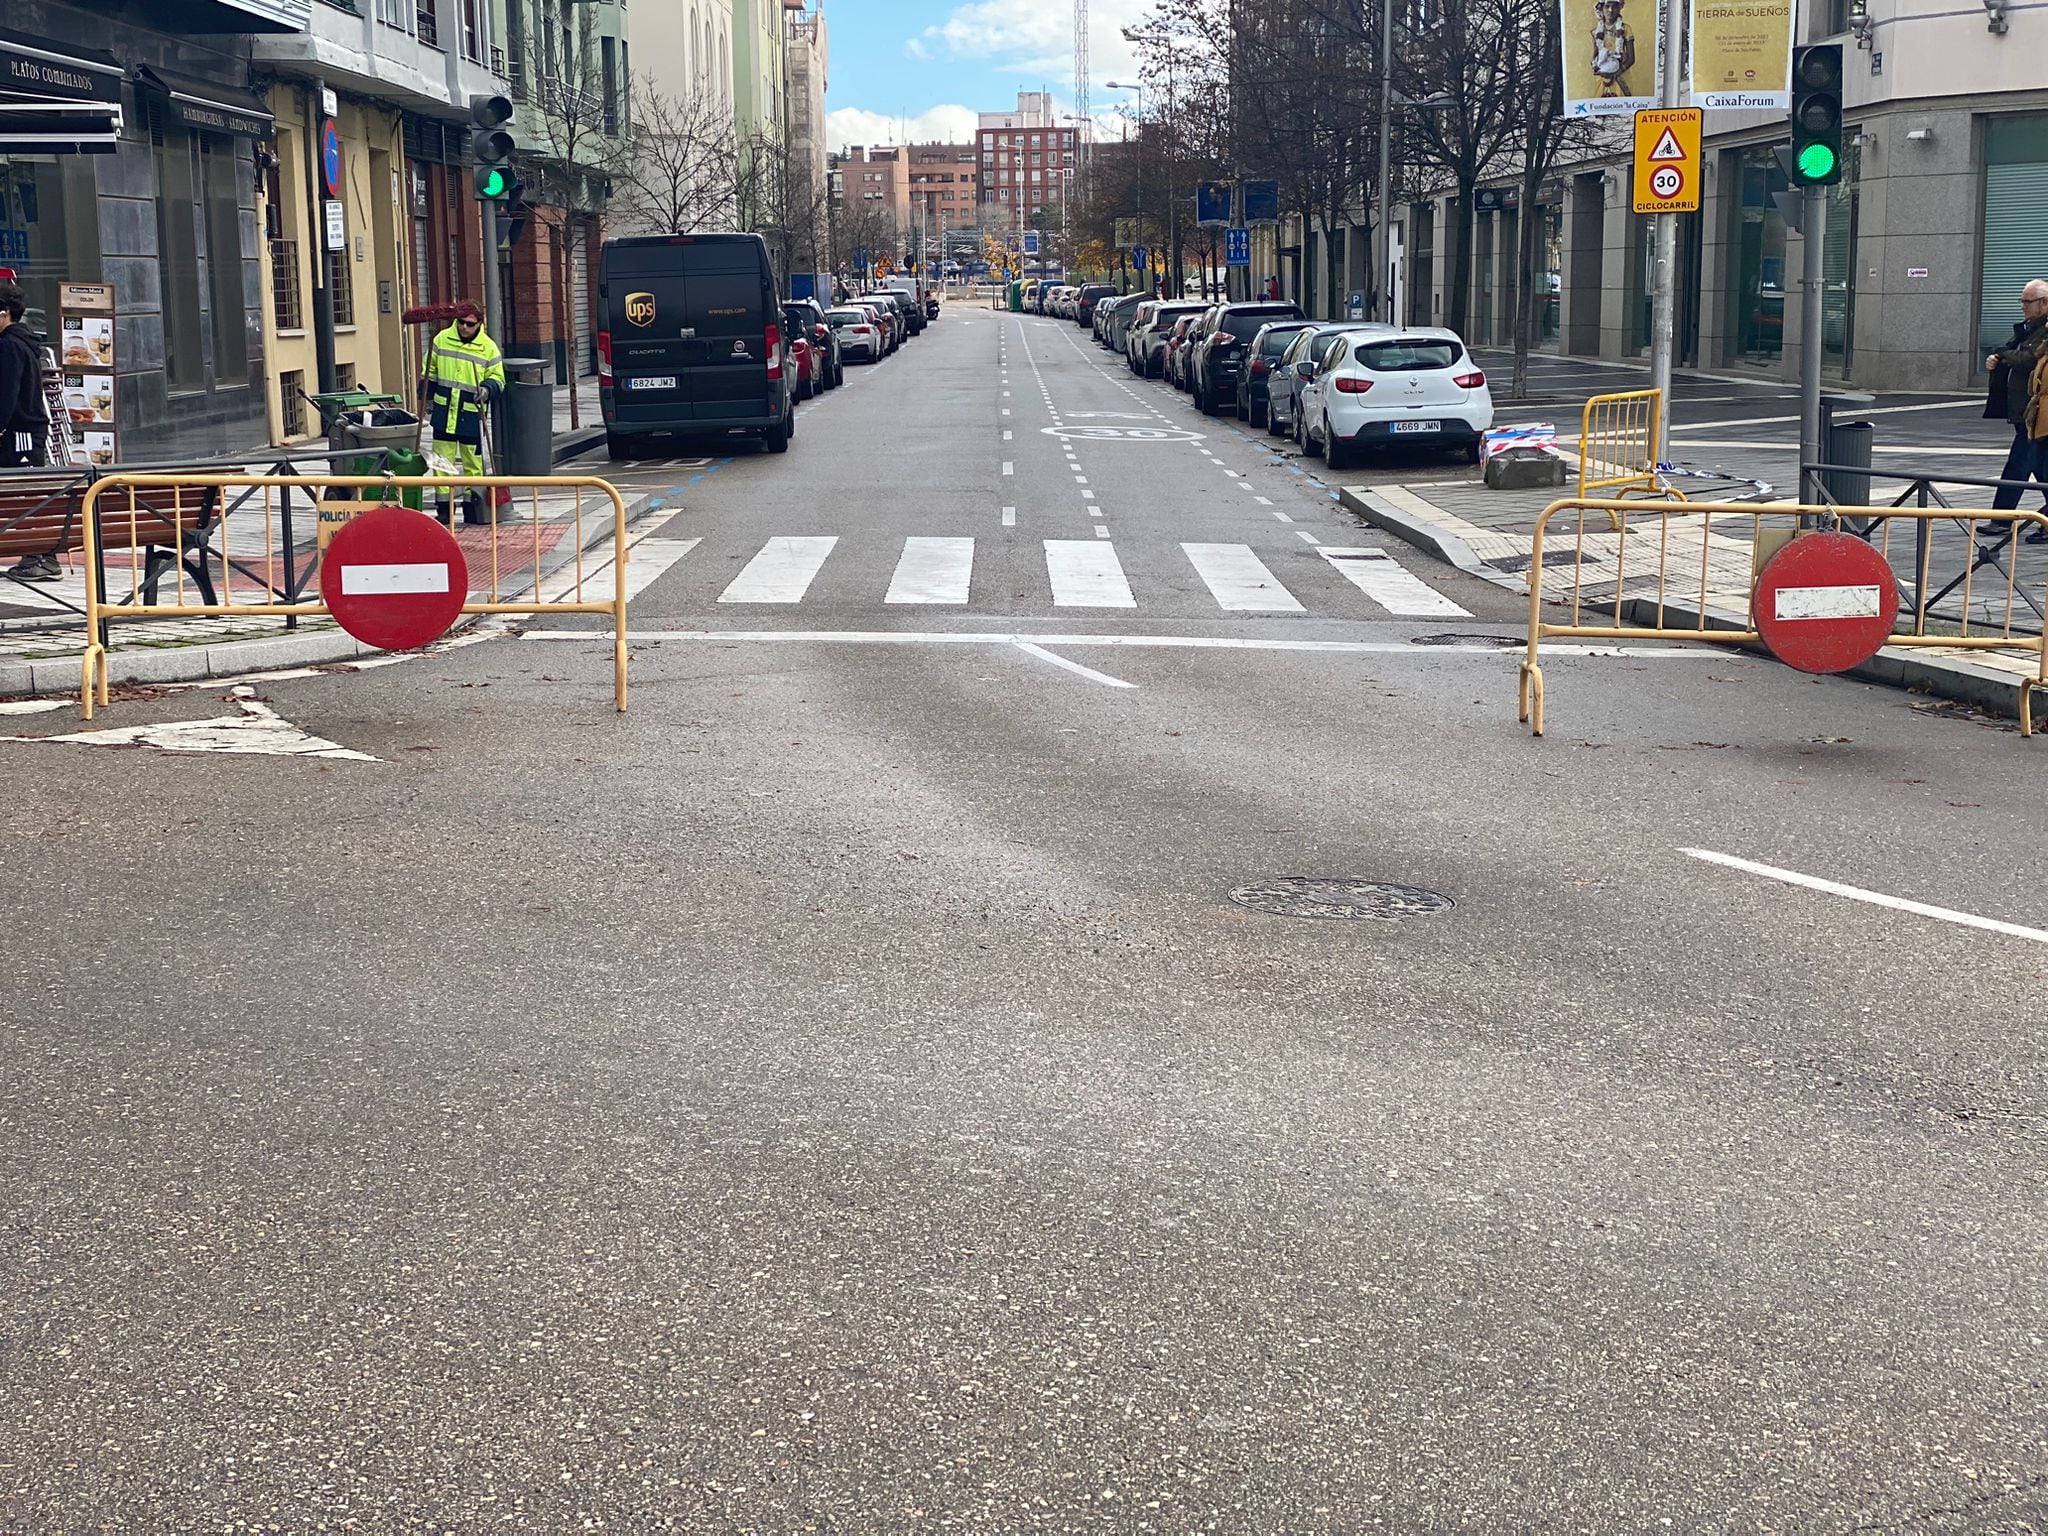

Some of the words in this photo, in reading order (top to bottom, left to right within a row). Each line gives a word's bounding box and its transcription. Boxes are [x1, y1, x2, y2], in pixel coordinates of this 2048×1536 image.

[1697, 9, 1735, 19] TIERRA
[1745, 6, 1790, 17] SUEÑOS
[11, 60, 40, 80] PLATOS
[42, 67, 93, 91] COMBINADOS
[1590, 102, 1624, 110] Fundación
[1705, 95, 1774, 107] CaixaForum
[1641, 112, 1696, 124] ATENCIÓN
[1656, 176, 1677, 188] 30
[1636, 201, 1695, 210] CICLOCARRIL
[1353, 295, 1360, 304] P
[628, 302, 654, 322] ups
[708, 307, 747, 315] www.ups.com
[633, 378, 655, 388] 6824
[658, 377, 674, 387] JMZ
[1396, 422, 1420, 431] 4669
[1422, 421, 1440, 431] JMN
[319, 508, 352, 522] POLICÍA
